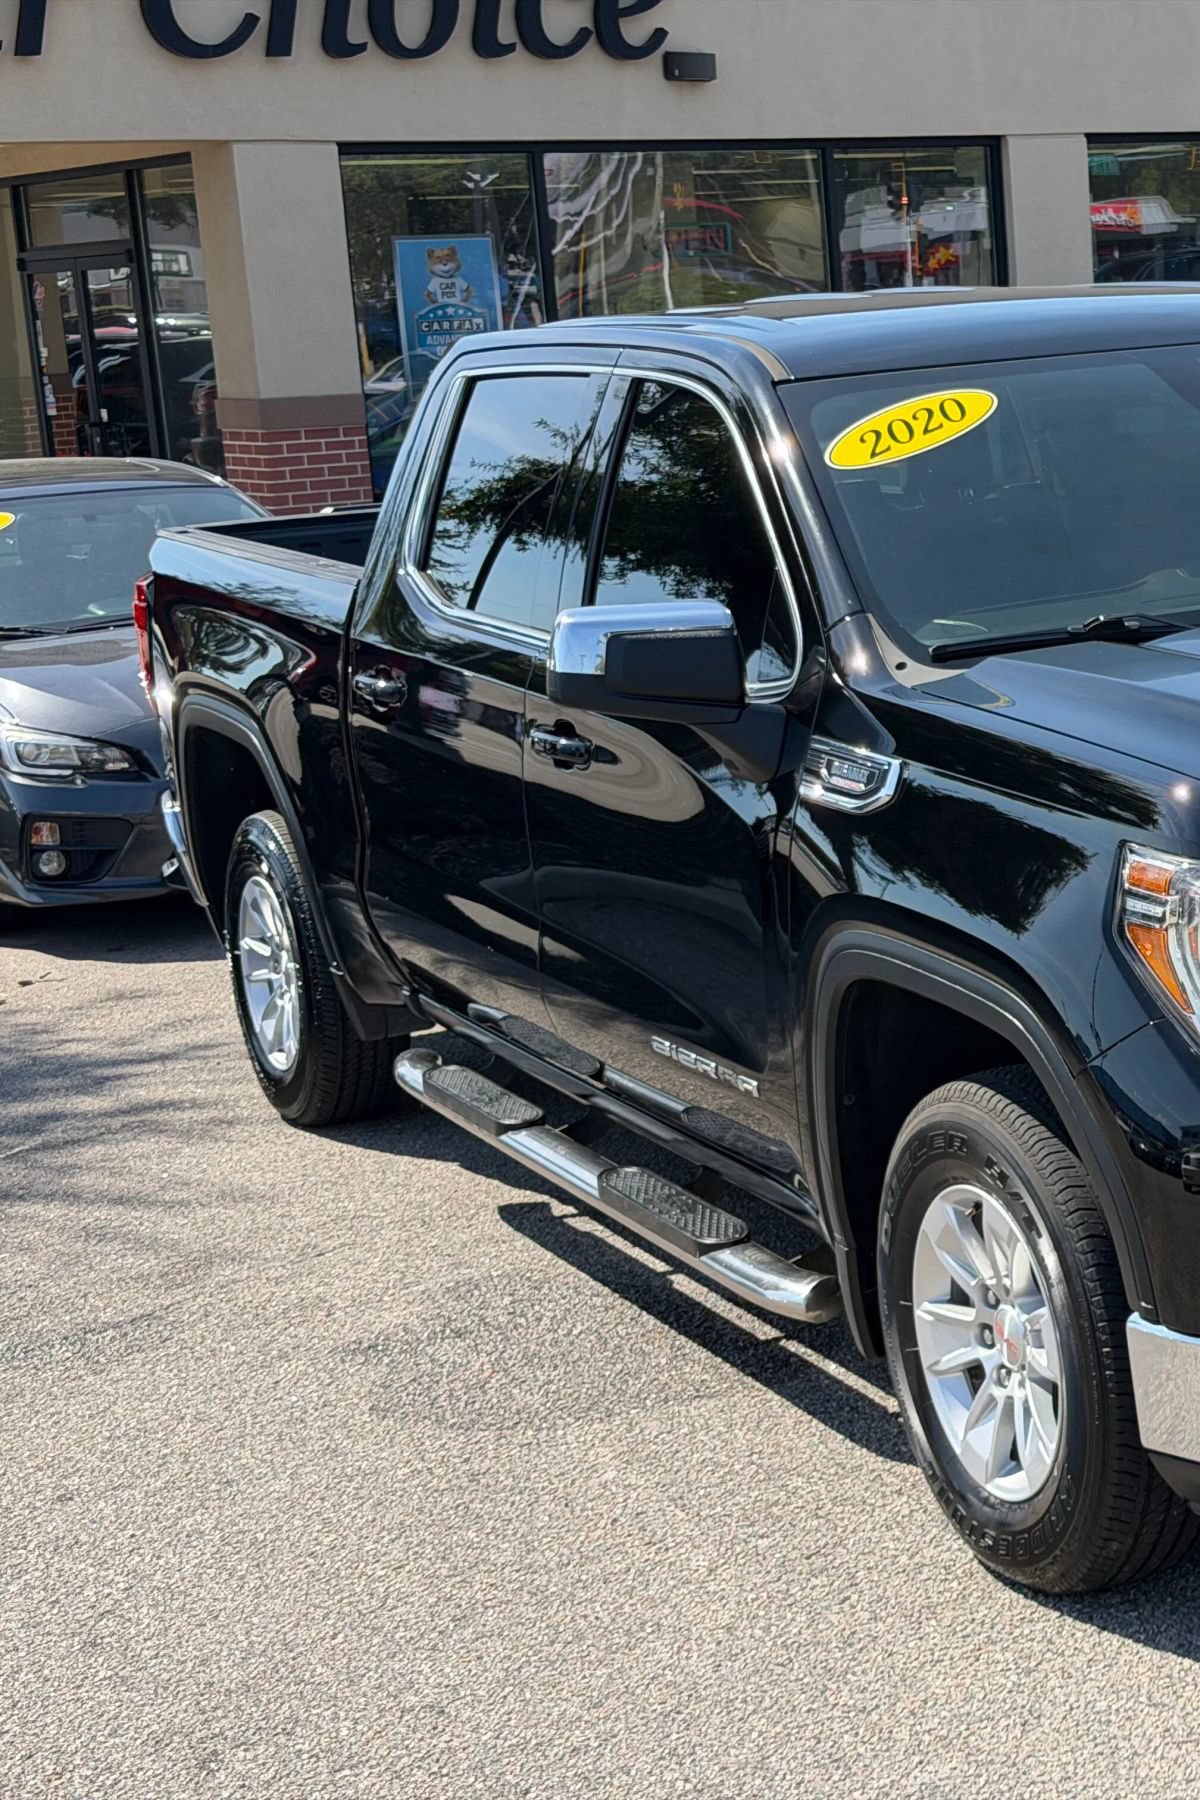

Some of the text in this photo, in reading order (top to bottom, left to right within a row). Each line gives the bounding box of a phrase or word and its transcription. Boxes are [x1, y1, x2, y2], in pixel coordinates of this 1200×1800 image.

[439, 281, 457, 291] CAR
[441, 291, 457, 300] FOX
[420, 319, 484, 332] CARFAX
[859, 397, 967, 459] 2020
[651, 1035, 760, 1098] SIERRA
[881, 1130, 1043, 1256] DUELER H/T
